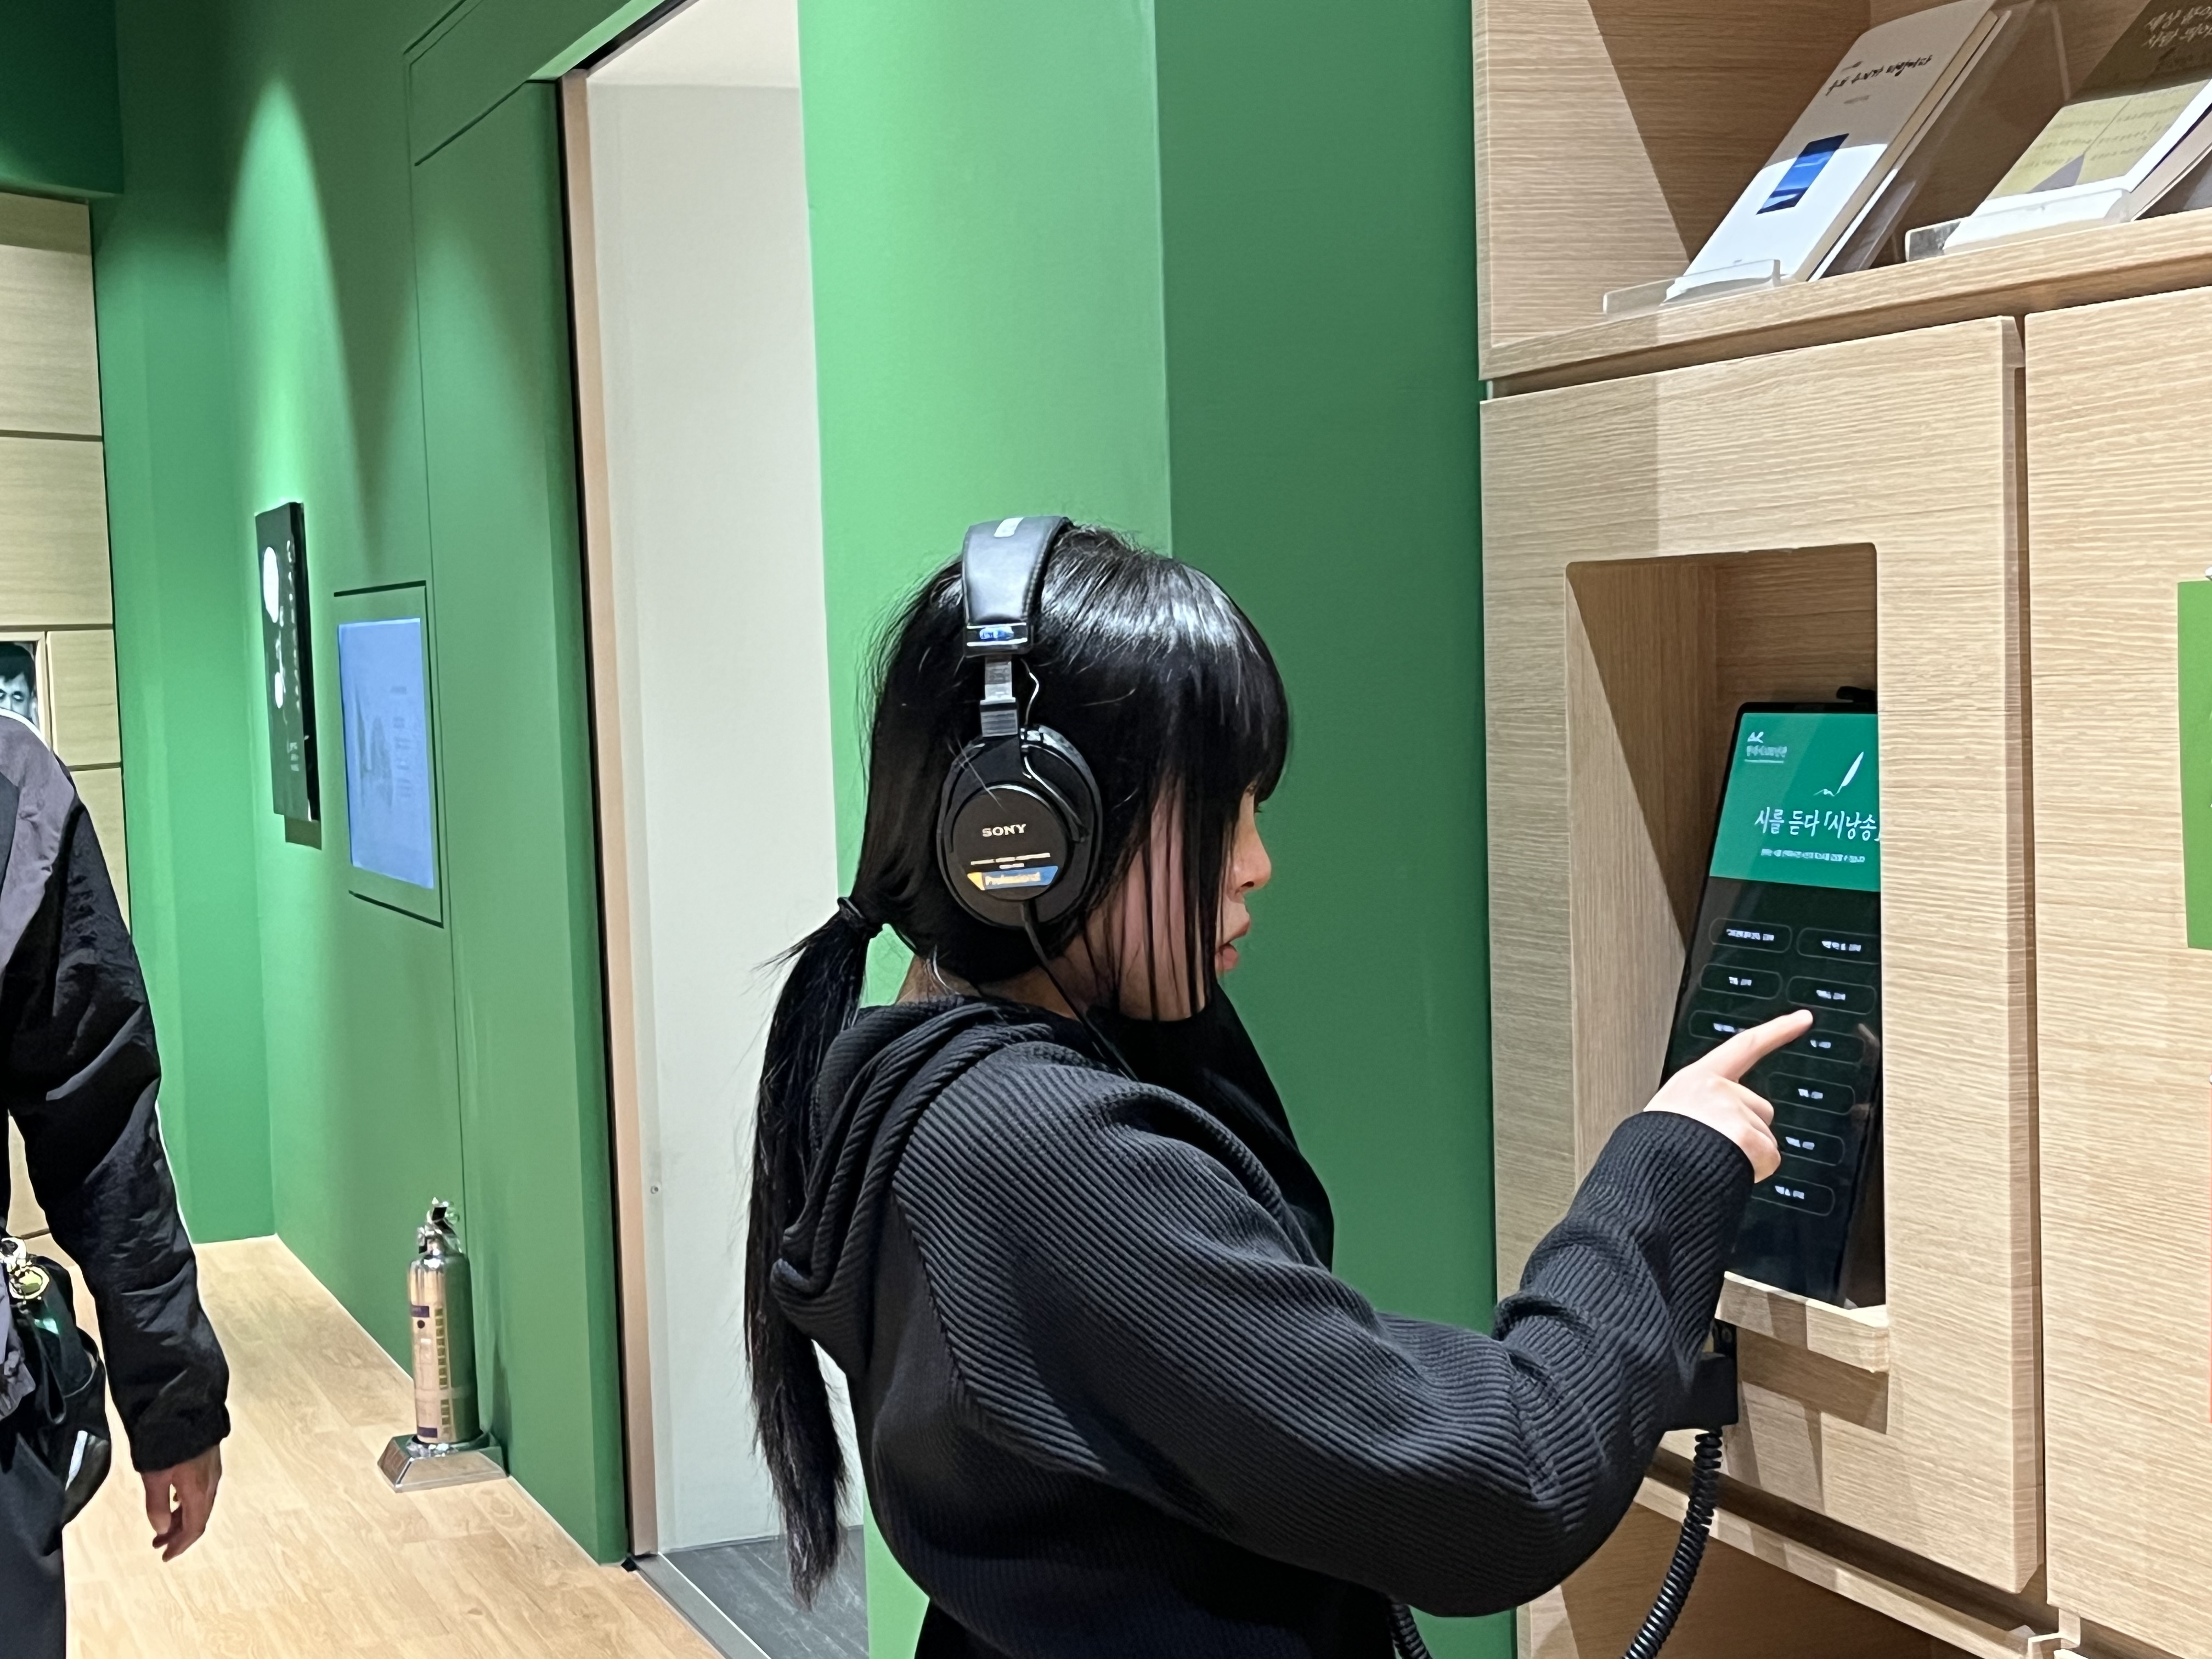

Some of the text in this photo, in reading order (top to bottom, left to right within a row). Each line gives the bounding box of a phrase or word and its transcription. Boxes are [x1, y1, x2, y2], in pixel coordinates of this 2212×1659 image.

[982, 823, 1026, 837] SONY
[1754, 806, 1785, 834] 시를
[1788, 809, 1820, 837] 듣다
